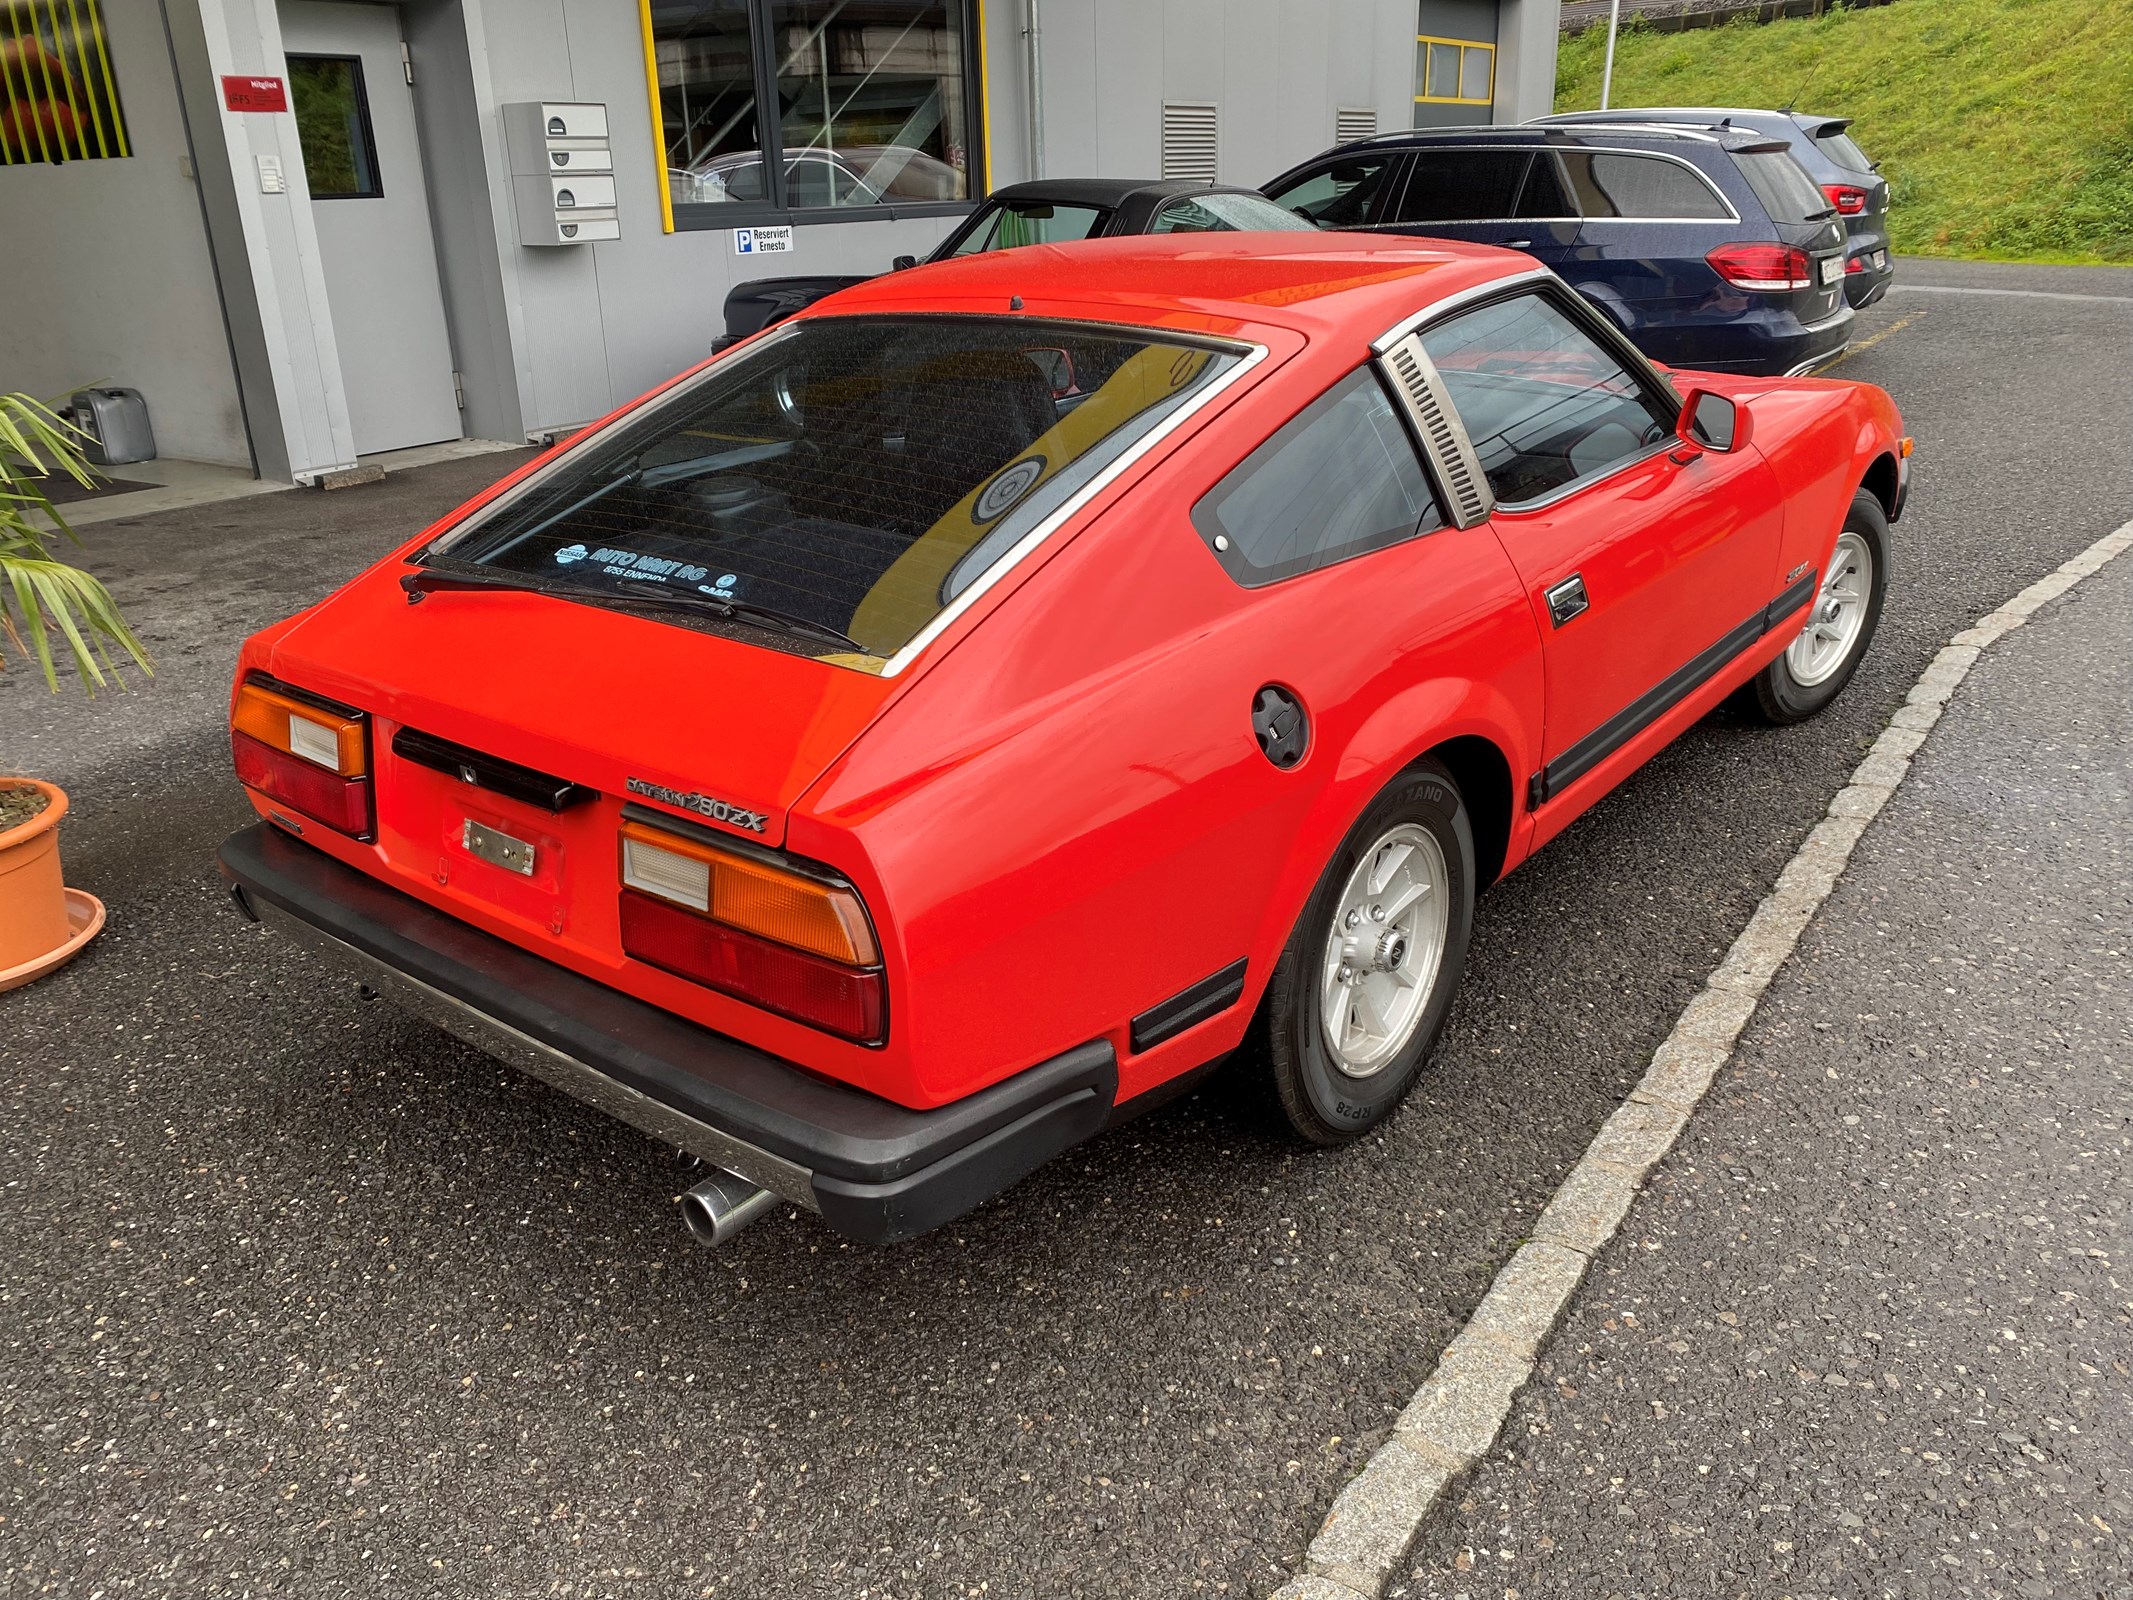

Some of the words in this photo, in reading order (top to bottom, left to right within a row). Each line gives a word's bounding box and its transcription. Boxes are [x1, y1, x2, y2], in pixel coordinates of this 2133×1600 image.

[250, 80, 278, 90] Mitglied
[739, 231, 751, 251] P
[753, 228, 789, 239] Reserviert
[759, 241, 785, 251] Ernesto
[557, 548, 584, 560] NISSAN
[588, 547, 638, 566] AUTO
[675, 565, 708, 580] AG
[602, 565, 624, 576] 8755
[621, 569, 667, 583] ENNENDA
[626, 776, 688, 808] DATSUN
[687, 792, 768, 832] 280ZX
[1336, 1101, 1372, 1119] RP28
